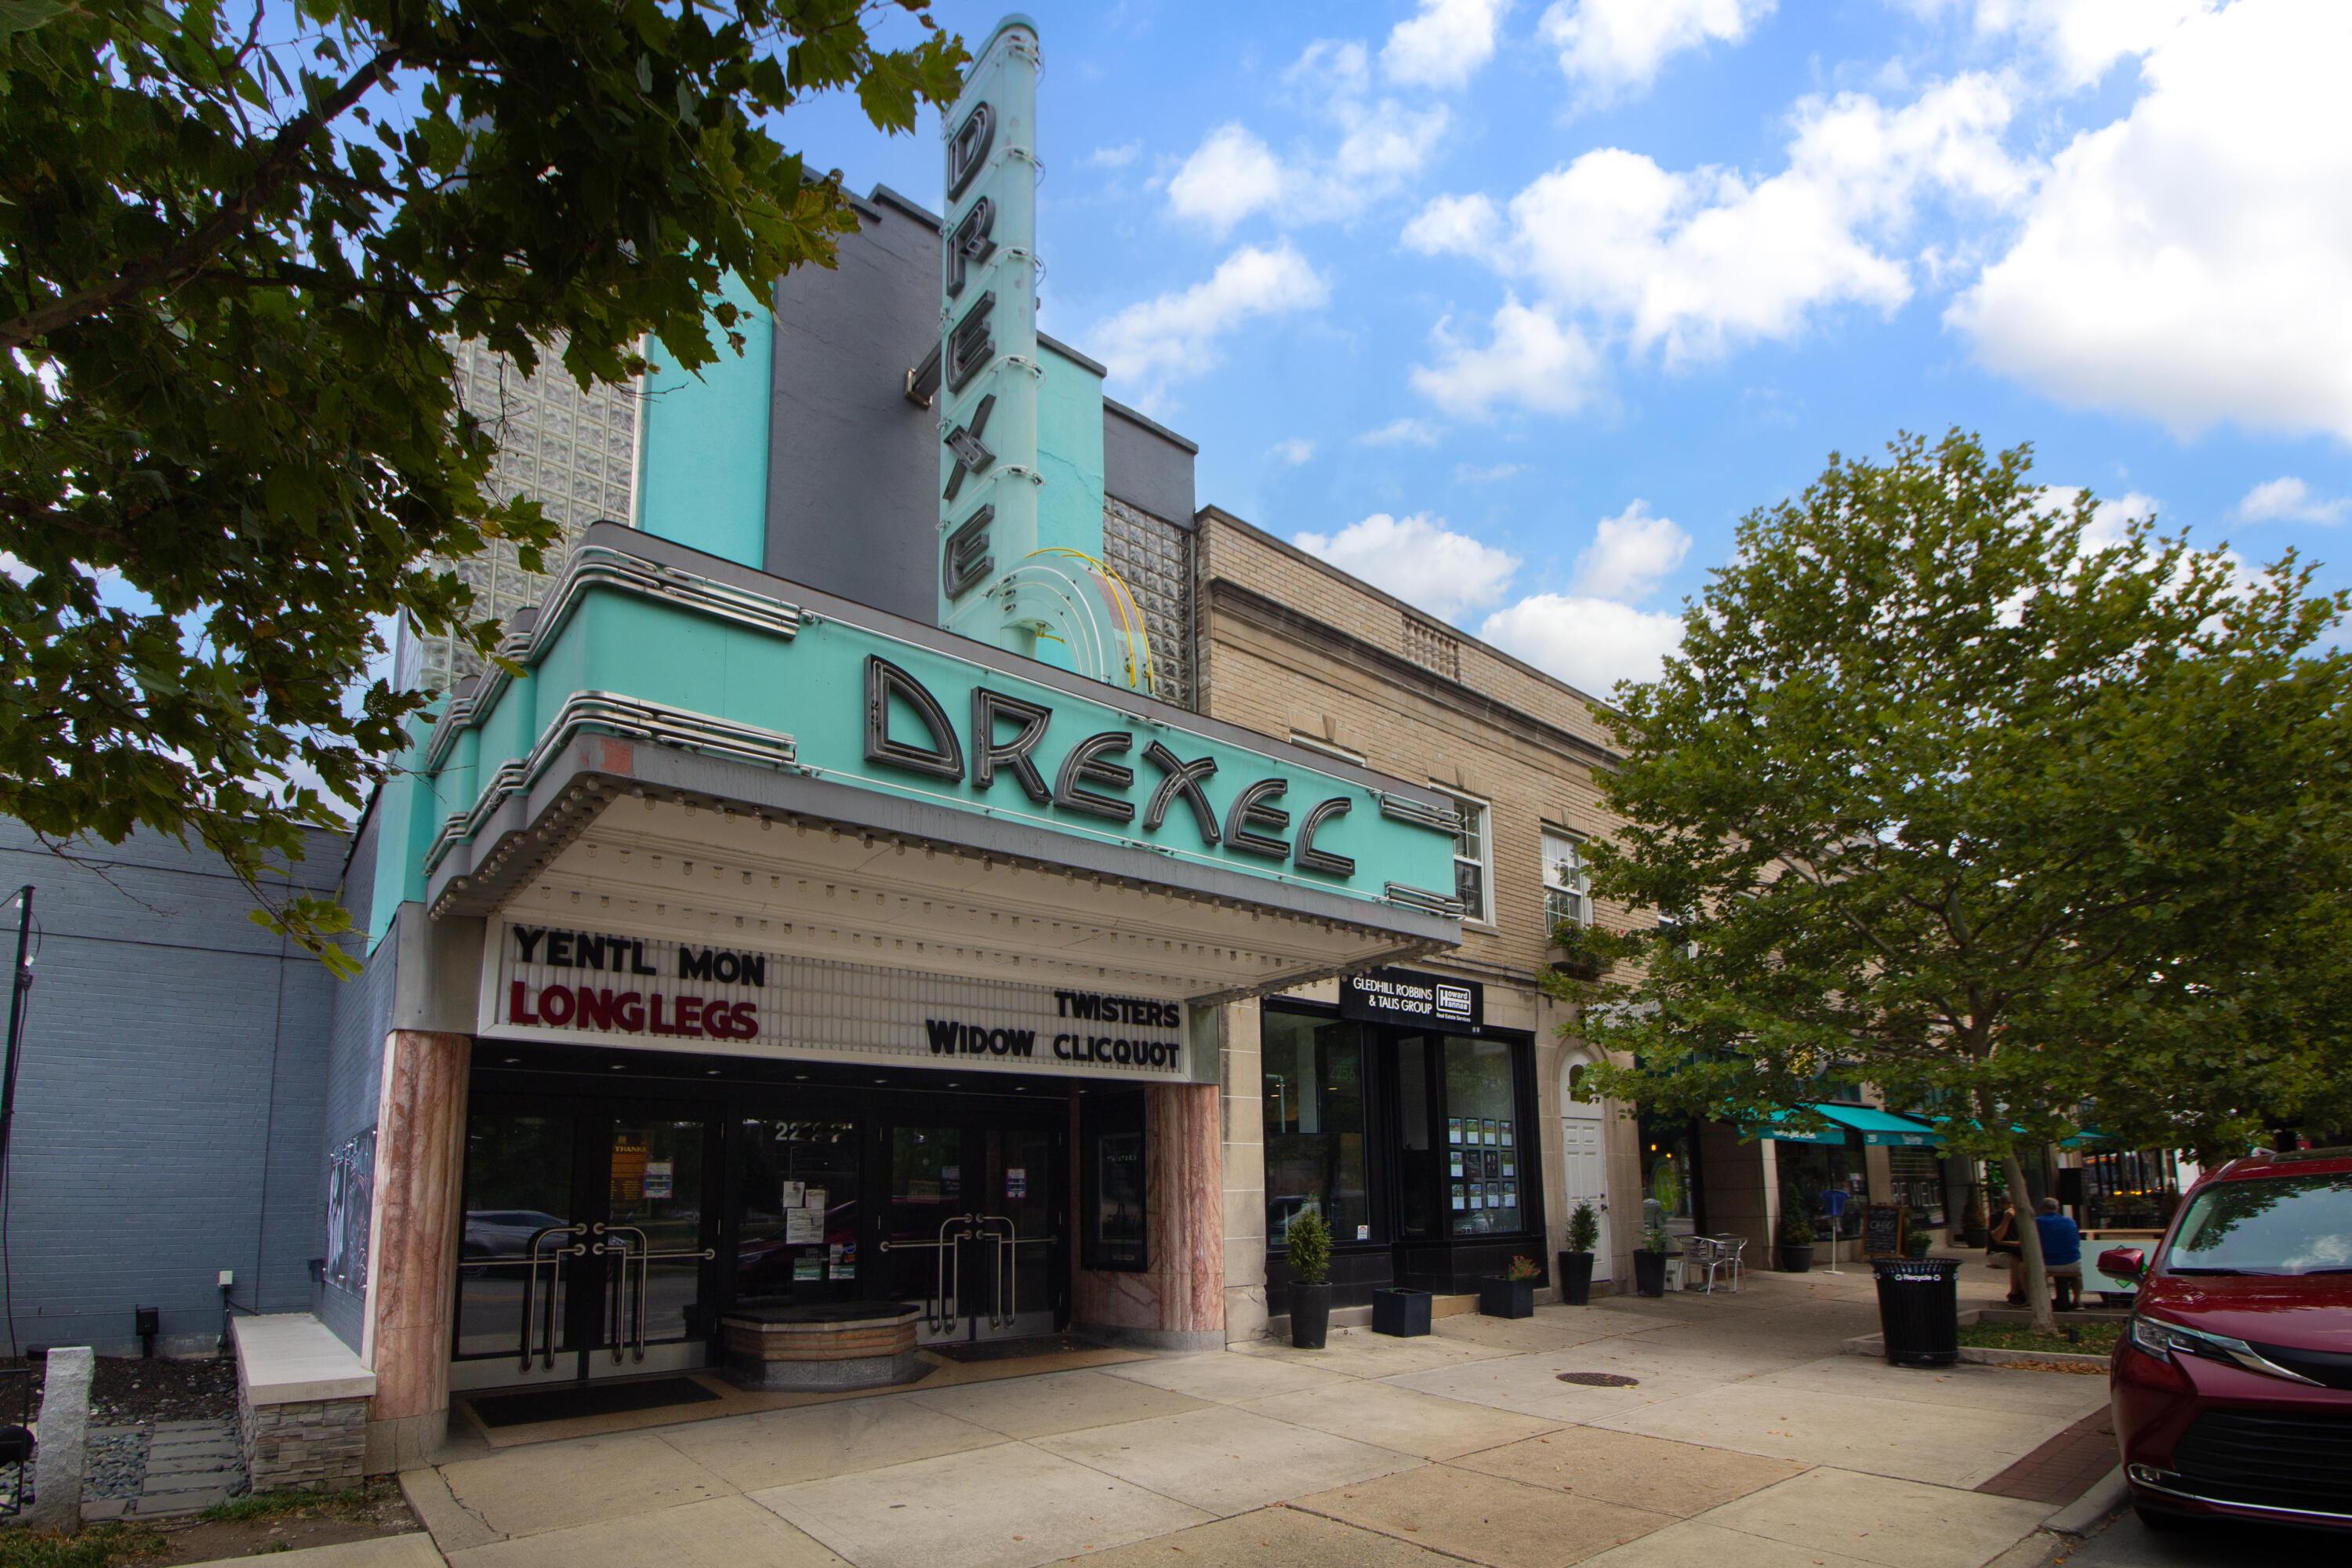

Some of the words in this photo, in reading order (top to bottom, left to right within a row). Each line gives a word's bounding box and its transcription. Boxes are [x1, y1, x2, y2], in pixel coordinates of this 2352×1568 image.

[514, 926, 657, 976] YENTL
[678, 946, 765, 987] MON
[1352, 977, 1395, 996] GLEDHILL
[1396, 983, 1433, 1002] ROBBINS
[1368, 994, 1376, 1007] &
[1377, 995, 1400, 1011] TALIS
[1400, 999, 1433, 1015] GROUP
[510, 980, 760, 1040] LONGLEGS
[1054, 991, 1181, 1029] TWISTERS
[926, 1019, 1036, 1057] WIDOW
[1053, 1034, 1180, 1068] CLICQUOT
[1329, 1065, 1356, 1080] 2256
[1903, 1273, 1933, 1282] Recycle
